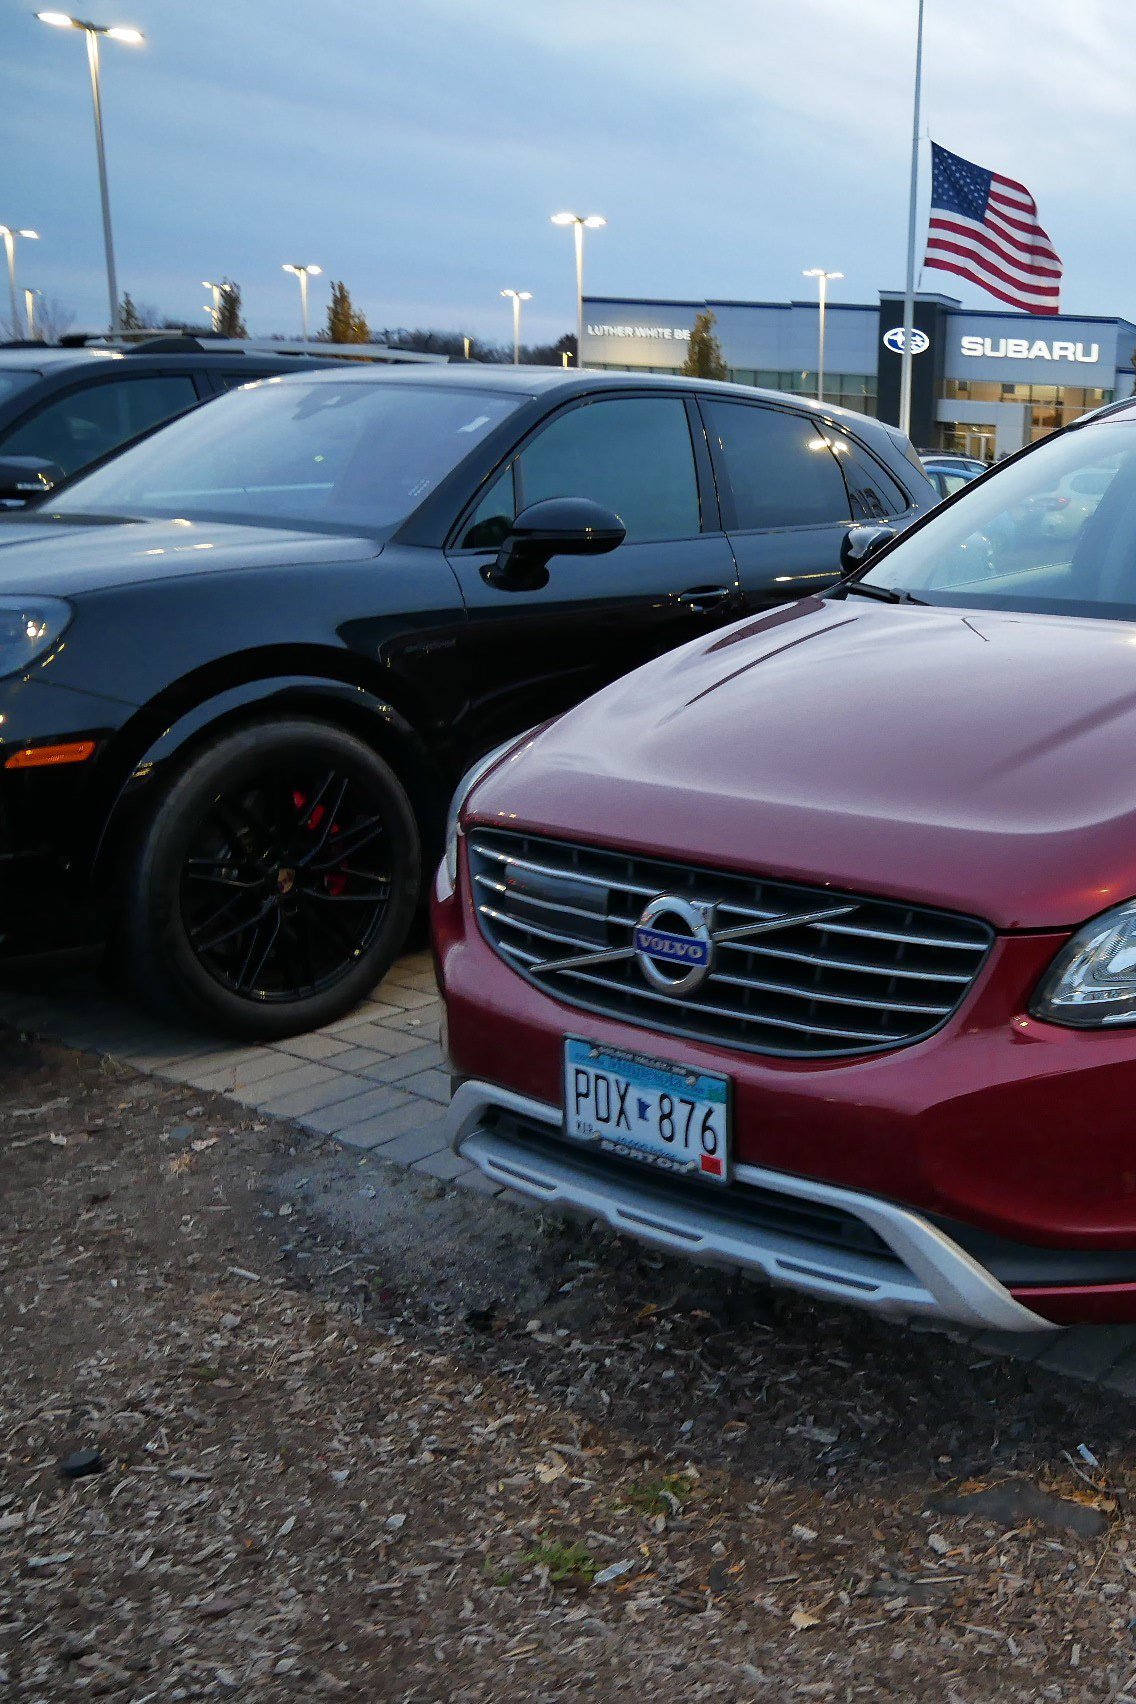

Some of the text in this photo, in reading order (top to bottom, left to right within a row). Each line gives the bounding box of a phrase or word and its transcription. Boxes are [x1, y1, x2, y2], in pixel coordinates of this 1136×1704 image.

[587, 324, 633, 337] LUTHER
[634, 326, 672, 340] WHITE
[960, 335, 1099, 363] SUBARU
[638, 932, 703, 959] VOLVO
[574, 1068, 632, 1131] PDX
[659, 1091, 717, 1156] 876
